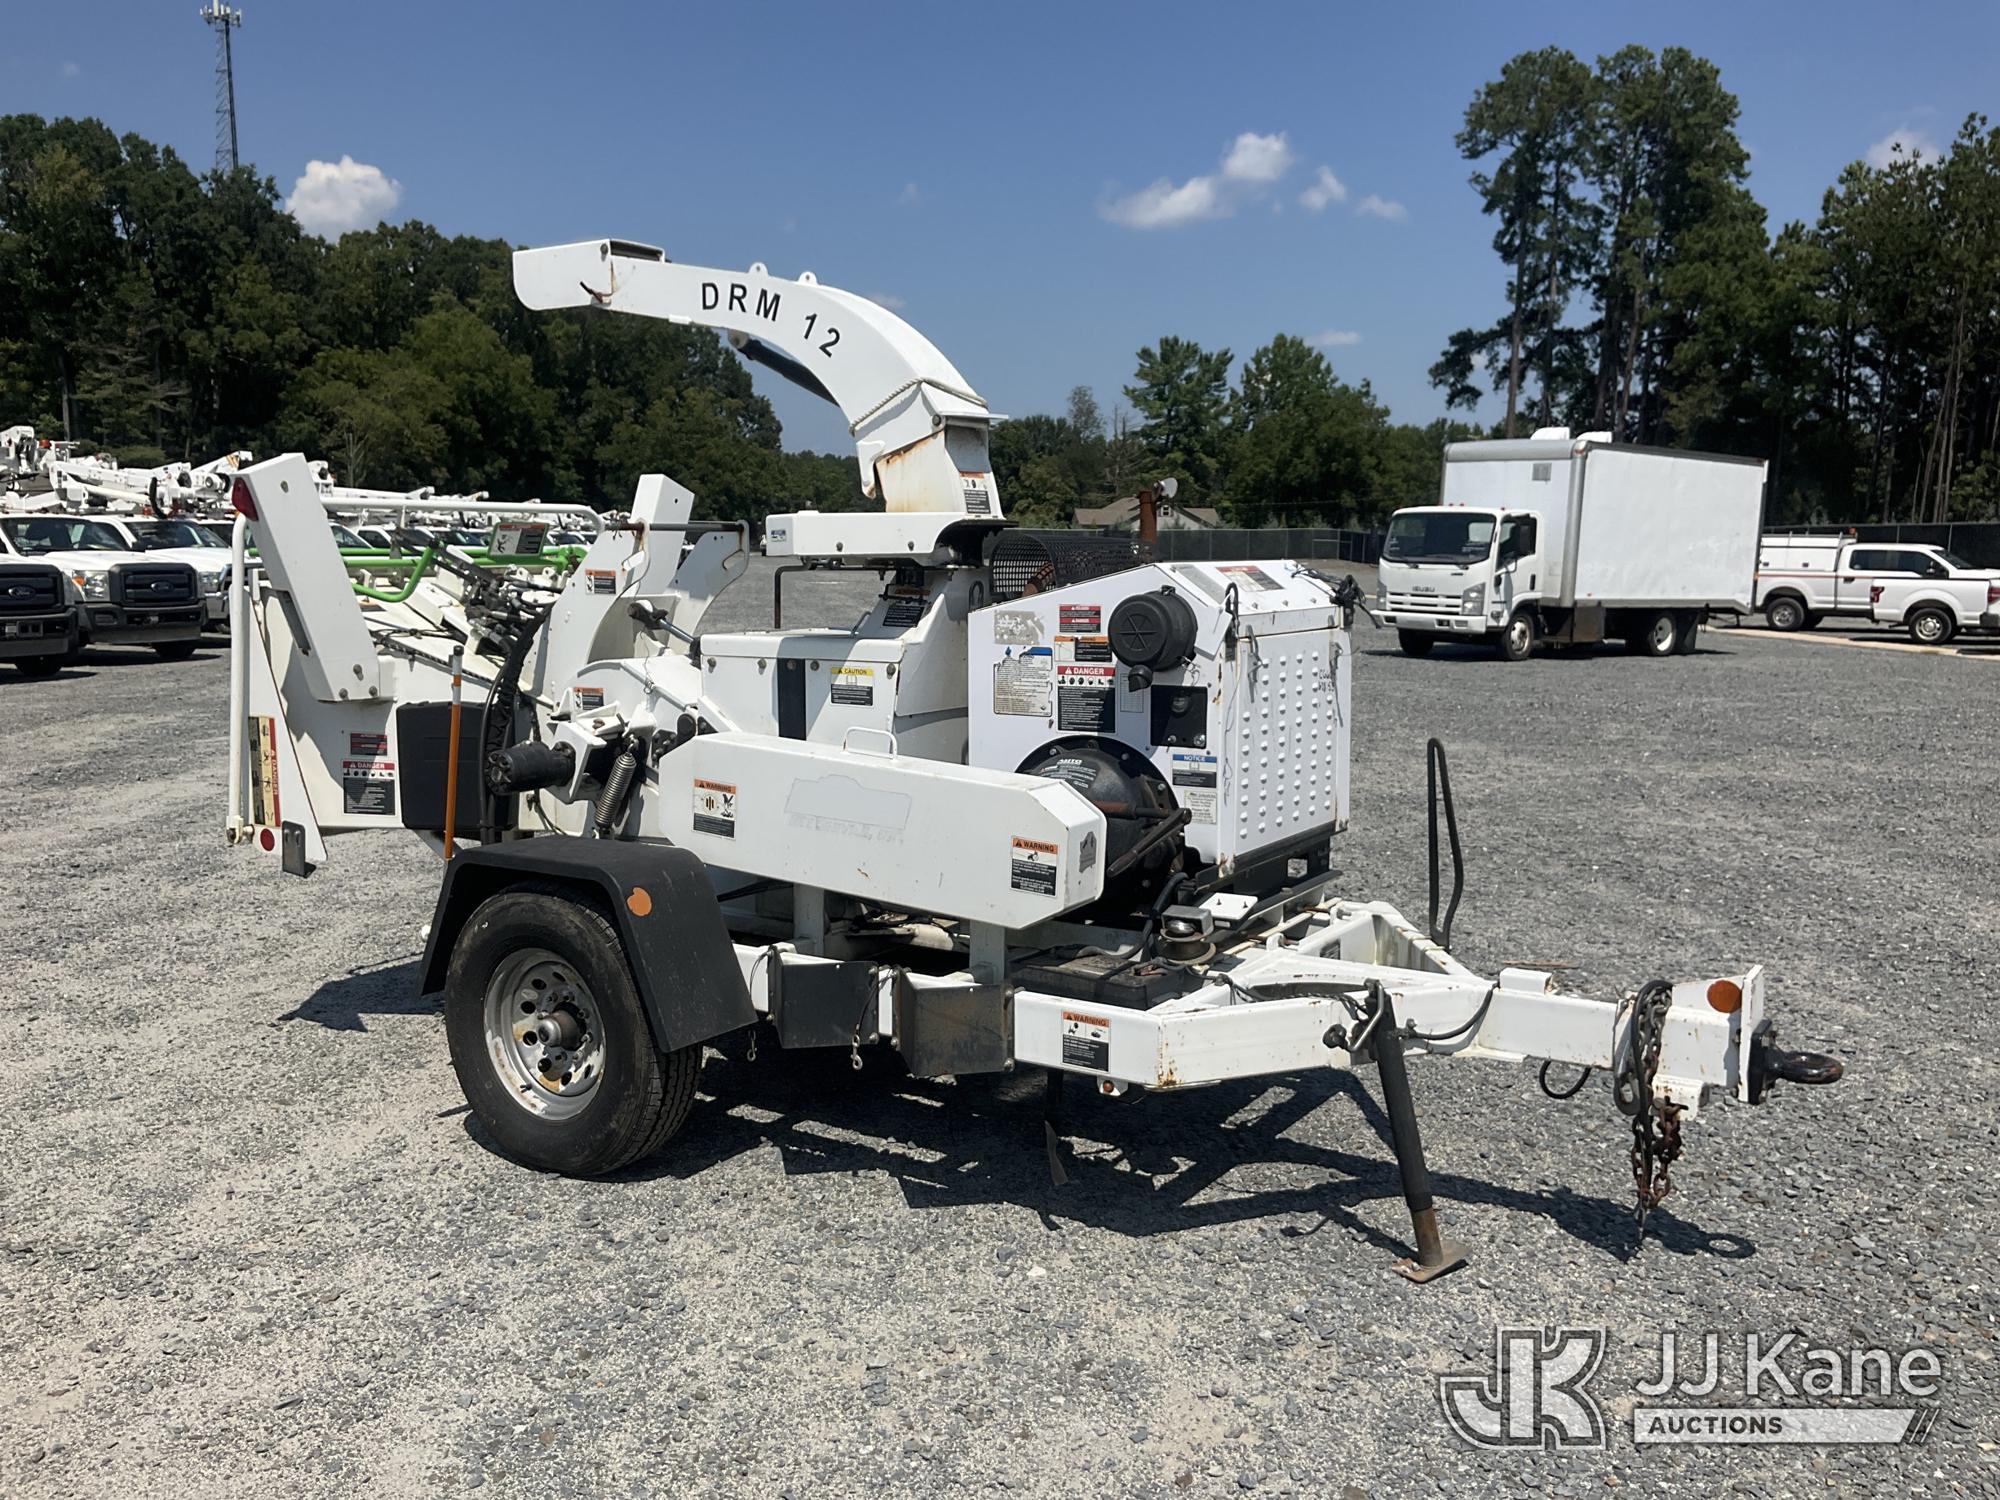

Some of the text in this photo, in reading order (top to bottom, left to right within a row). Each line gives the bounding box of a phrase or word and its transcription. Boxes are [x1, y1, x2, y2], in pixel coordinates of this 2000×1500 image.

[701, 281, 841, 358] DRM 12
[1073, 667, 1105, 675] DANGER
[705, 781, 732, 793] WARNING
[1023, 840, 1054, 852] WARNING
[1073, 1013, 1107, 1026] WARNING
